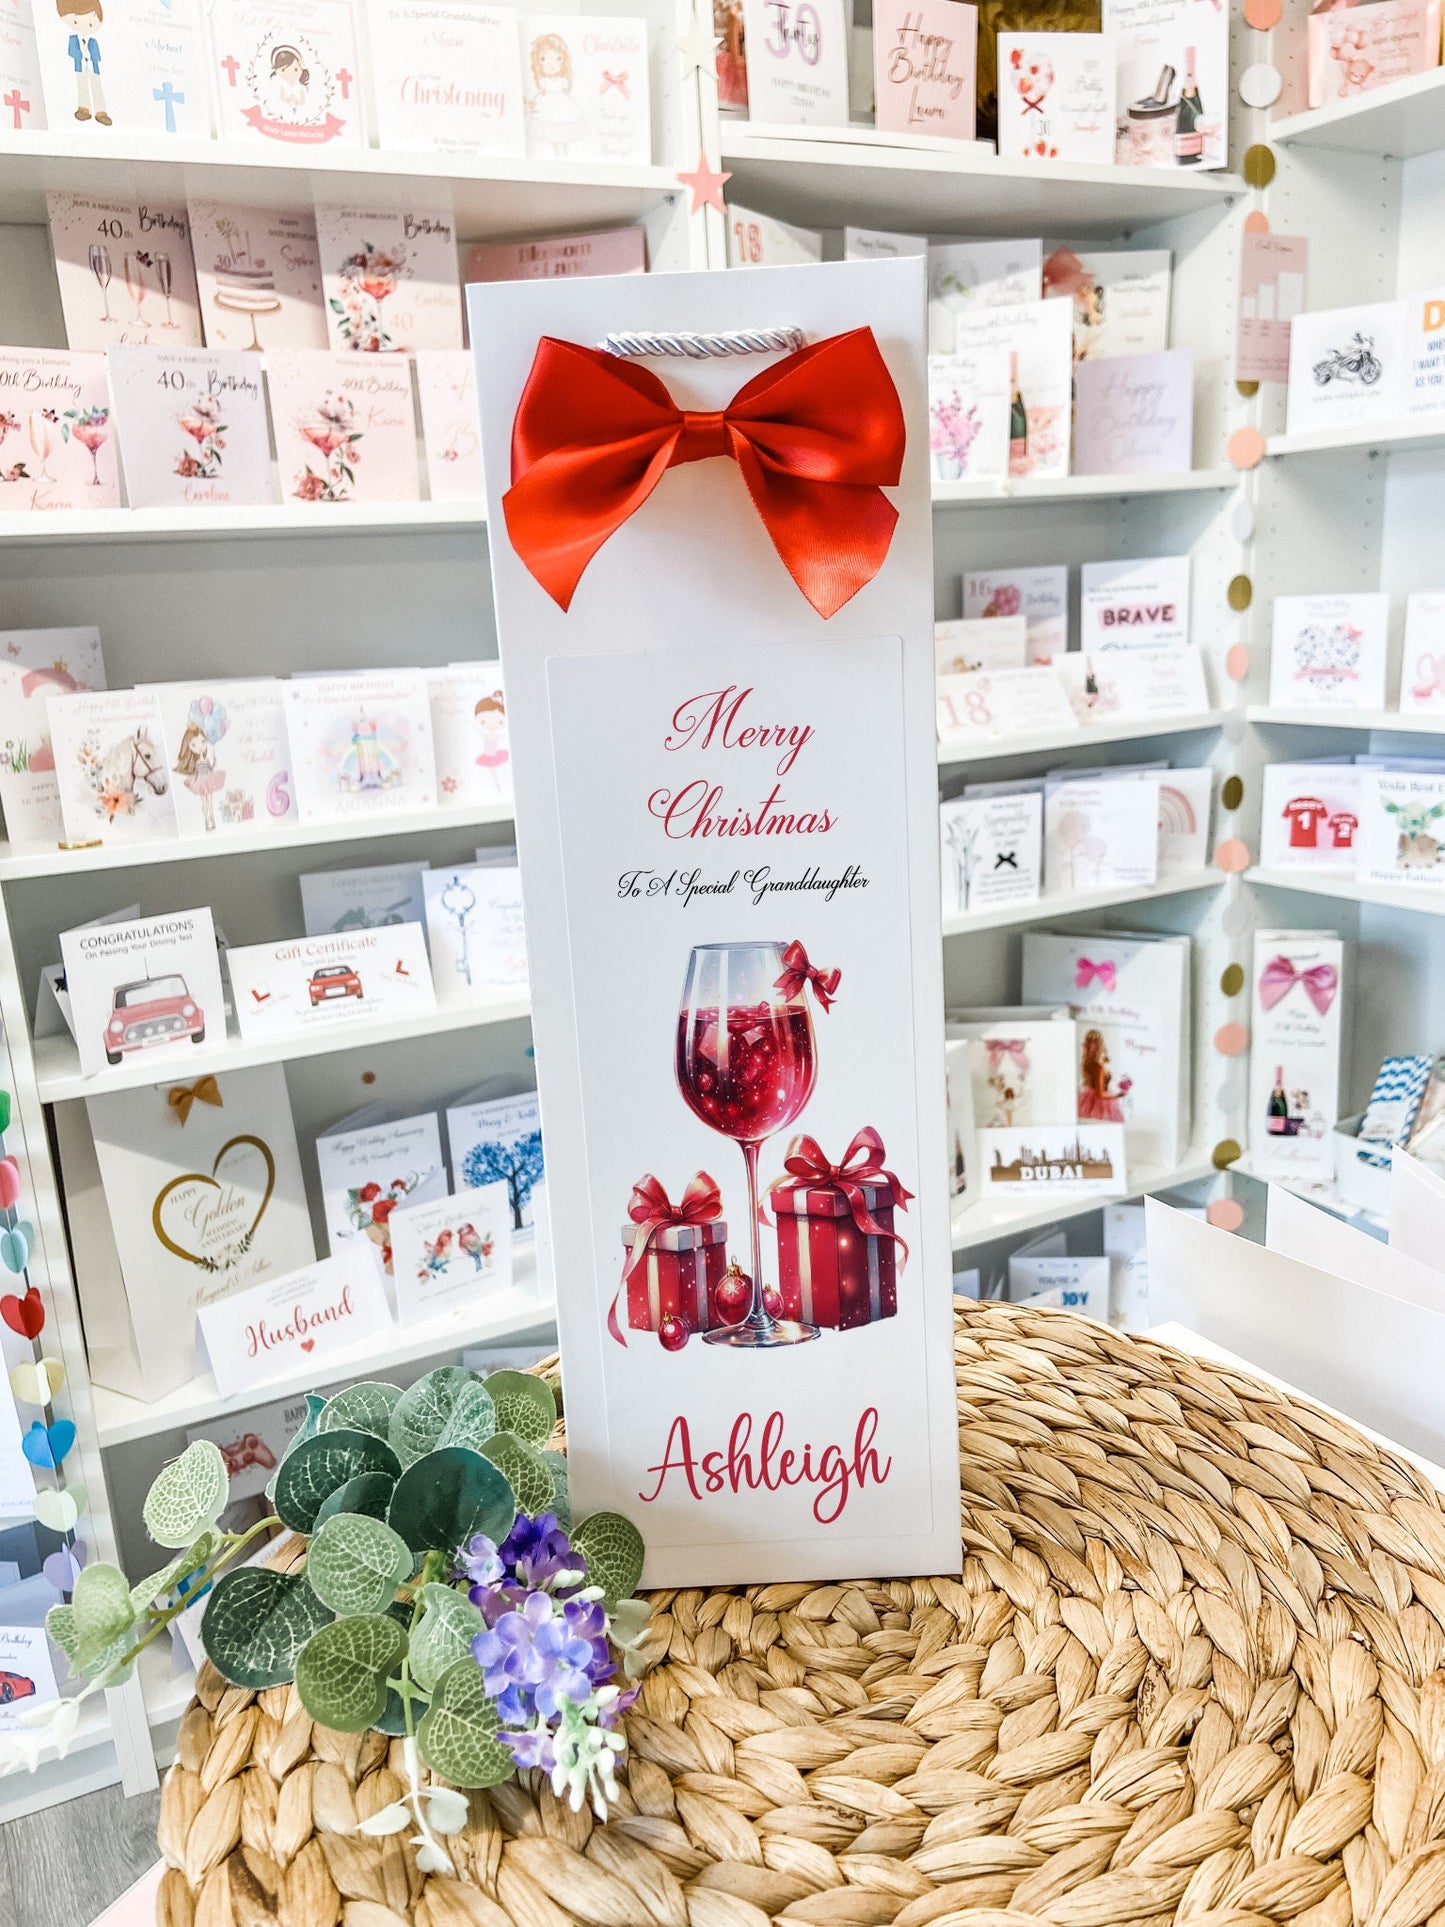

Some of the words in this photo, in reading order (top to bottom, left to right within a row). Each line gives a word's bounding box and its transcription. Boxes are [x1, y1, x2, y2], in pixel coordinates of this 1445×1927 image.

[400, 76, 507, 119] Christening
[138, 205, 187, 237] Birthday
[402, 212, 451, 244] Birthday
[734, 221, 763, 264] 18
[23, 368, 82, 398] Birthday
[207, 369, 259, 400] Birthday
[366, 375, 409, 400] Birthday
[30, 488, 73, 511] Karen
[1102, 604, 1175, 627] BRAVE
[938, 691, 993, 729] 18
[664, 685, 816, 776] Merry
[267, 771, 291, 818] 6
[648, 780, 838, 840] Christmas
[1298, 811, 1311, 830] 1
[1338, 822, 1351, 838] 2
[617, 869, 655, 899] To
[646, 869, 678, 898] A
[675, 867, 741, 908] Special
[743, 865, 871, 906] Granddaughter
[79, 919, 195, 951] CONGRATULATIONS
[85, 951, 98, 961] On
[100, 947, 129, 958] Passing
[131, 942, 147, 952] Your
[149, 937, 177, 950] Driving
[178, 933, 193, 943] Test
[274, 946, 301, 962] Gift
[306, 935, 378, 957] Certificate
[1020, 1163, 1084, 1180] DUBAI
[170, 1188, 198, 1204] HAPPY
[184, 1184, 246, 1240] Golden
[244, 1285, 354, 1358] Husband
[638, 1406, 892, 1524] Ashleigh
[1, 1631, 33, 1649] Birthday
